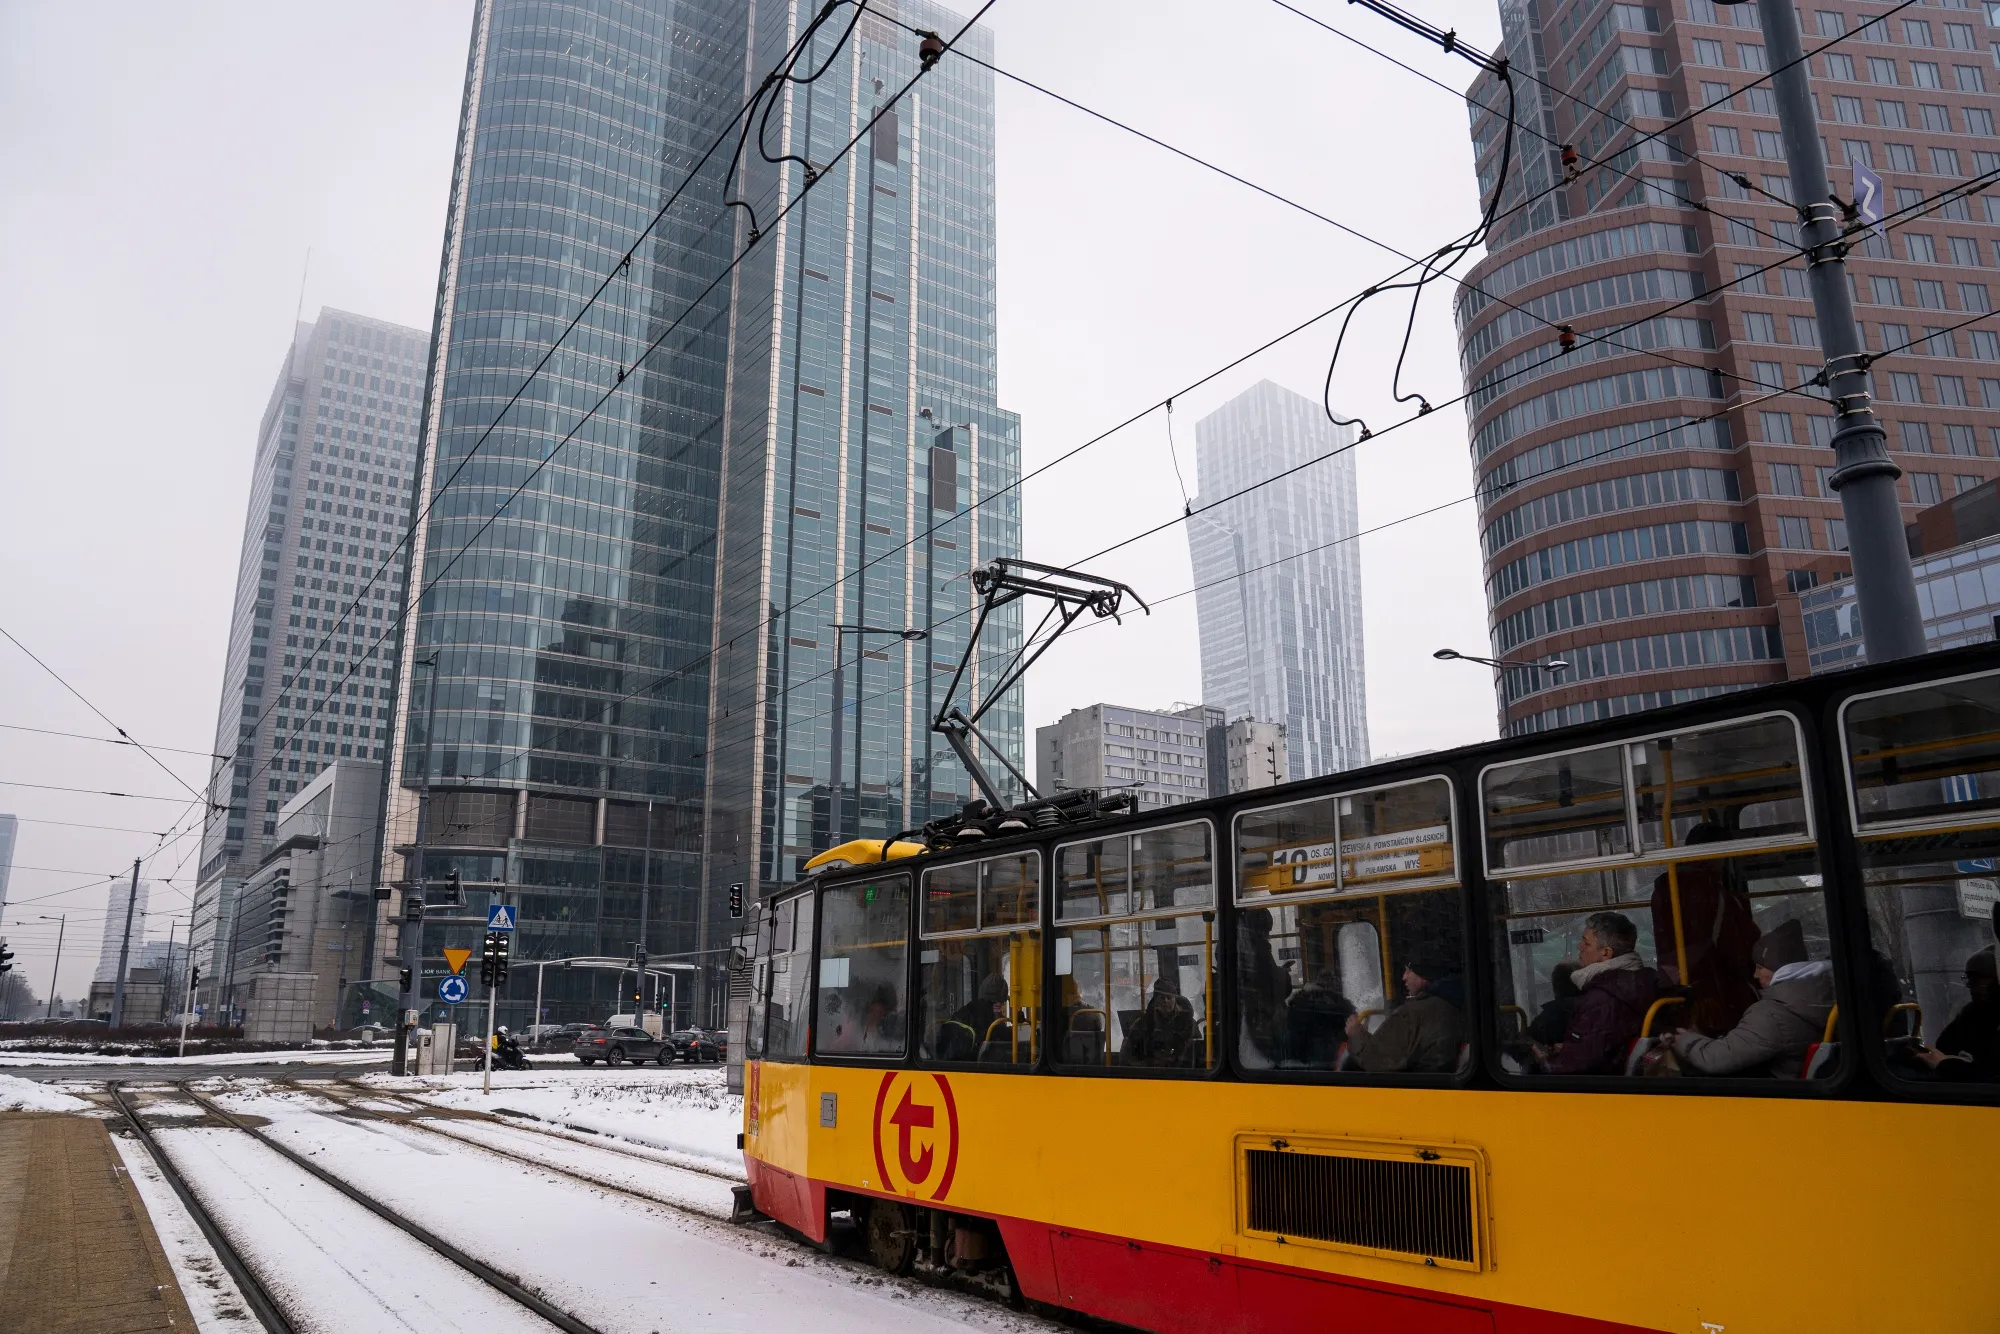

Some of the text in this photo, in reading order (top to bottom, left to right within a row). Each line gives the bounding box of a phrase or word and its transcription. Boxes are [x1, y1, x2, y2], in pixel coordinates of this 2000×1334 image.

[1311, 832, 1444, 859] OS. GÓZEWSKA POWSTAŃCÓW ŚLĄSKICH
[1366, 864, 1397, 874] PUŁAWSKA
